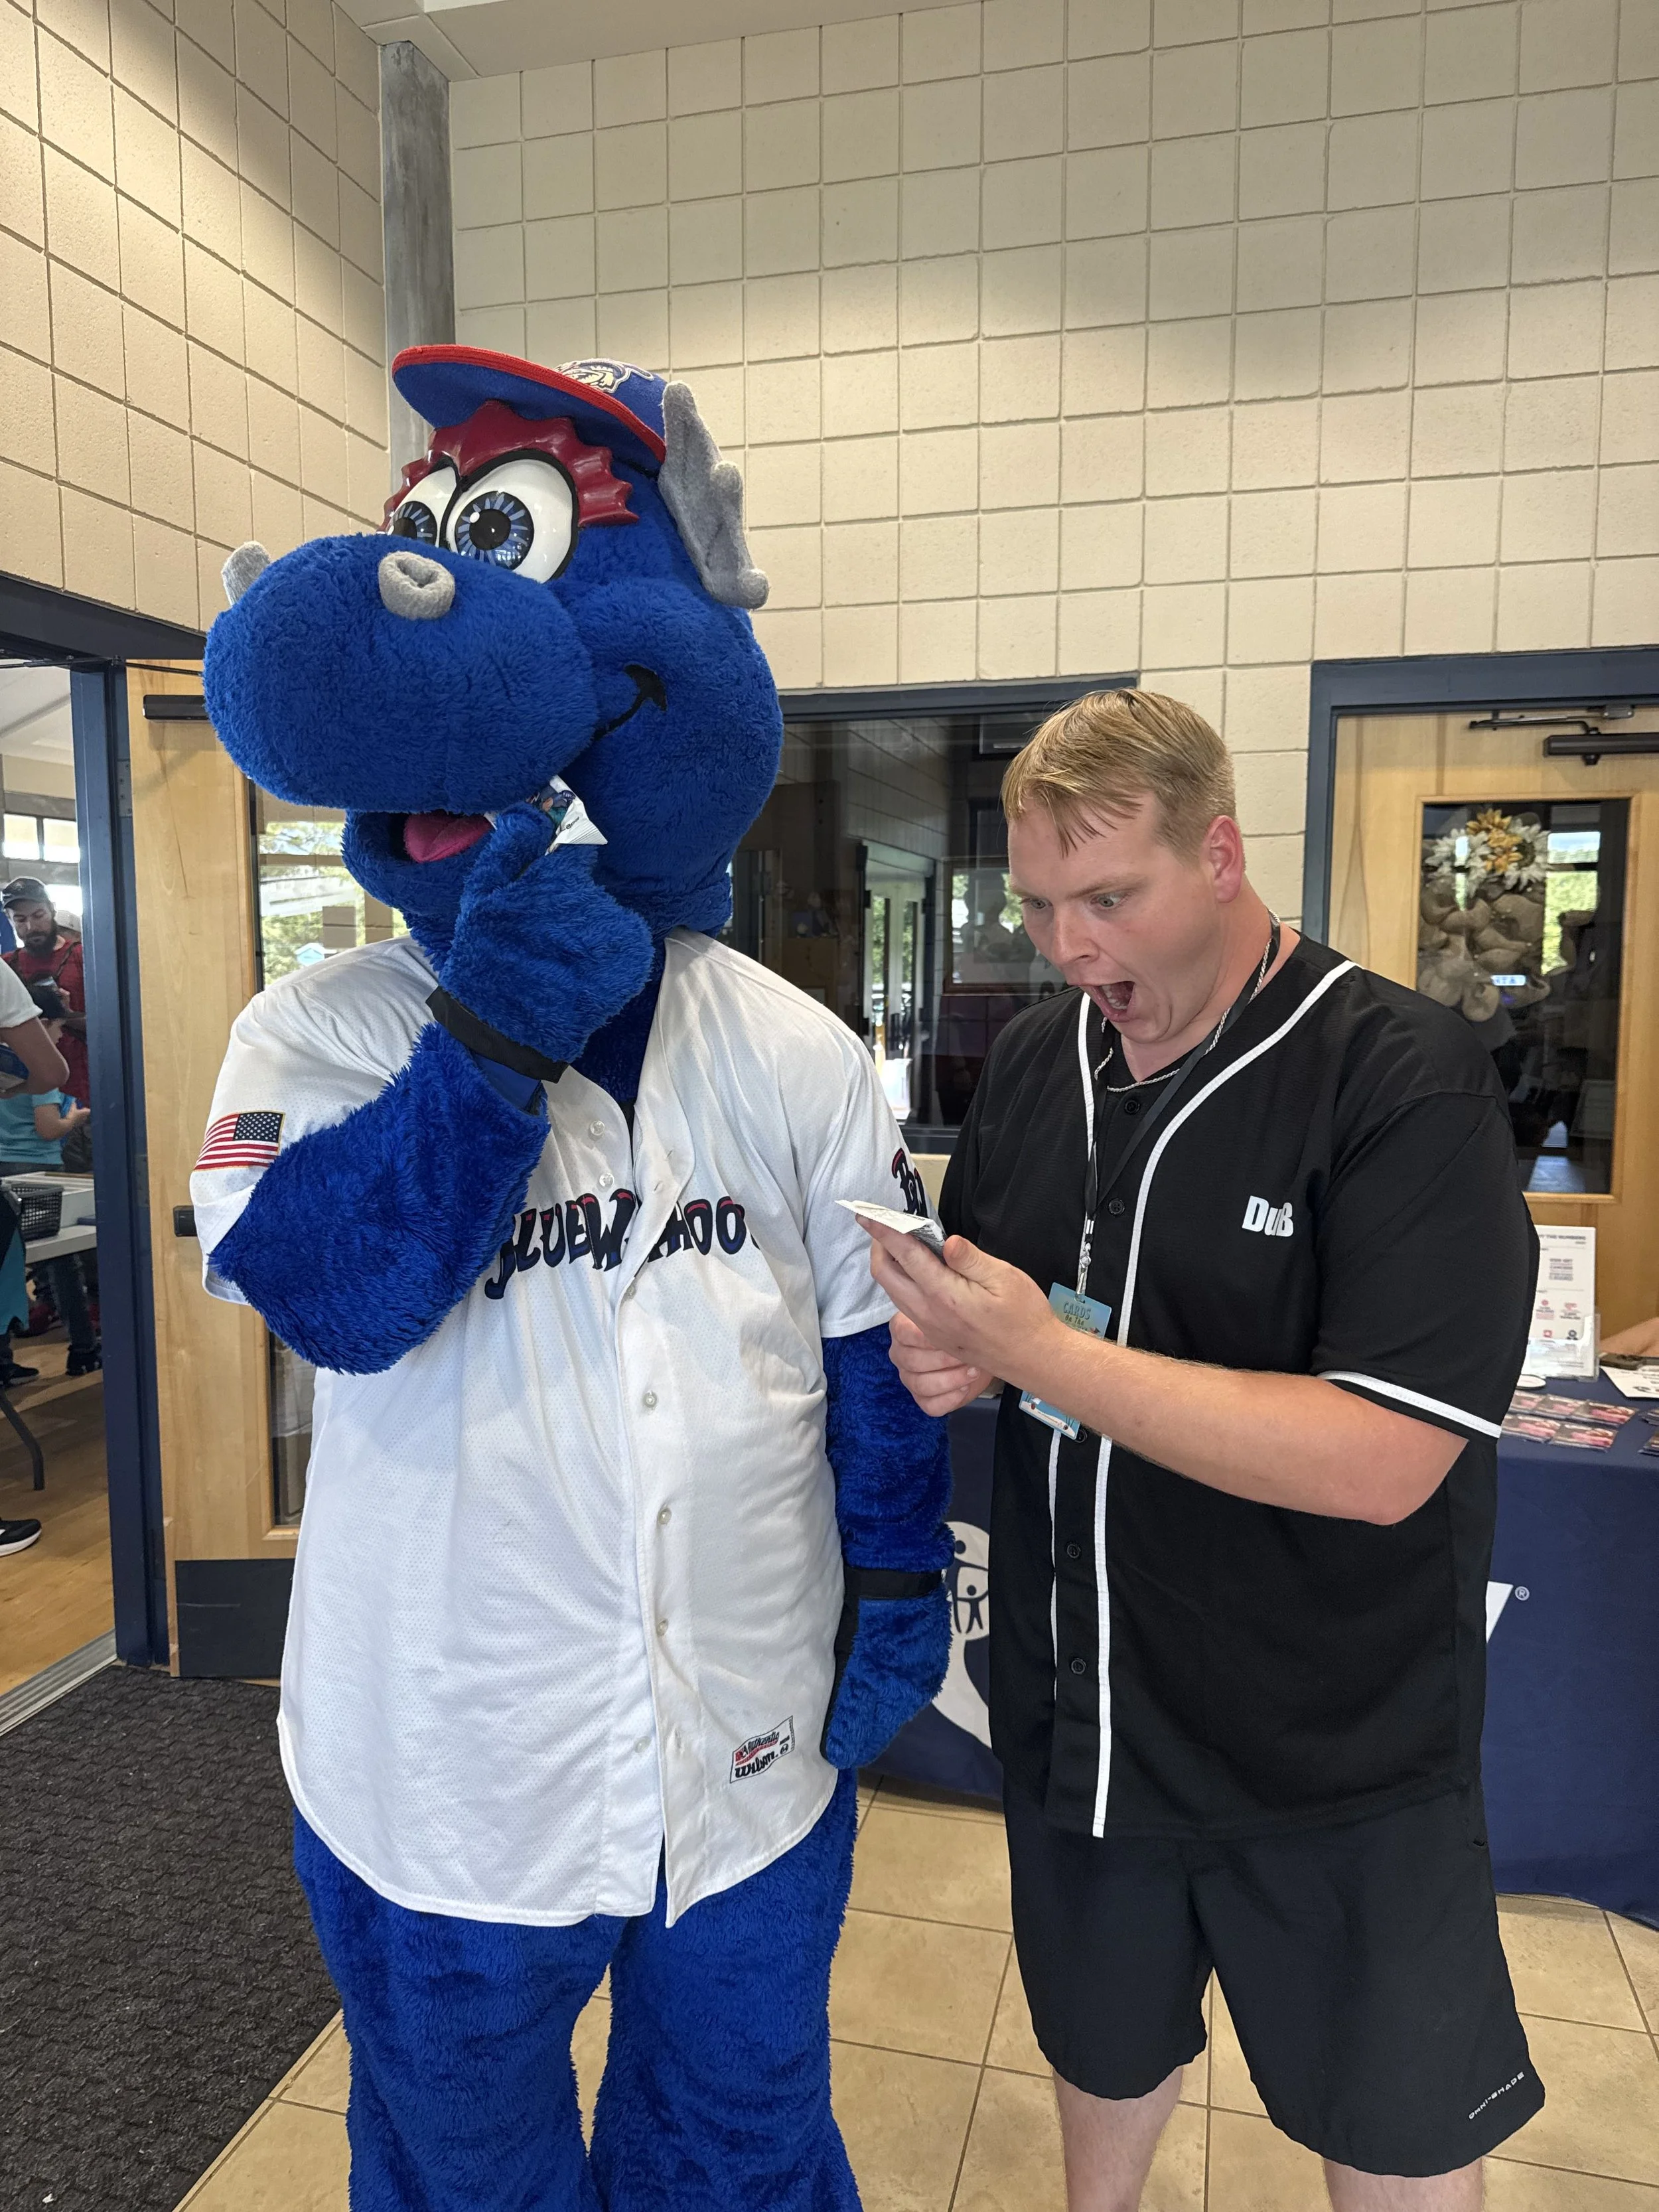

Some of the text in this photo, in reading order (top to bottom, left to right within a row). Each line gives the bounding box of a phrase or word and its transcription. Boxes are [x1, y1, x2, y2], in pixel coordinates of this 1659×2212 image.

[1063, 1301, 1092, 1320] CARDS
[1074, 1317, 1085, 1326] The
[1469, 2071, 1525, 2120] OMNI-SHADE
